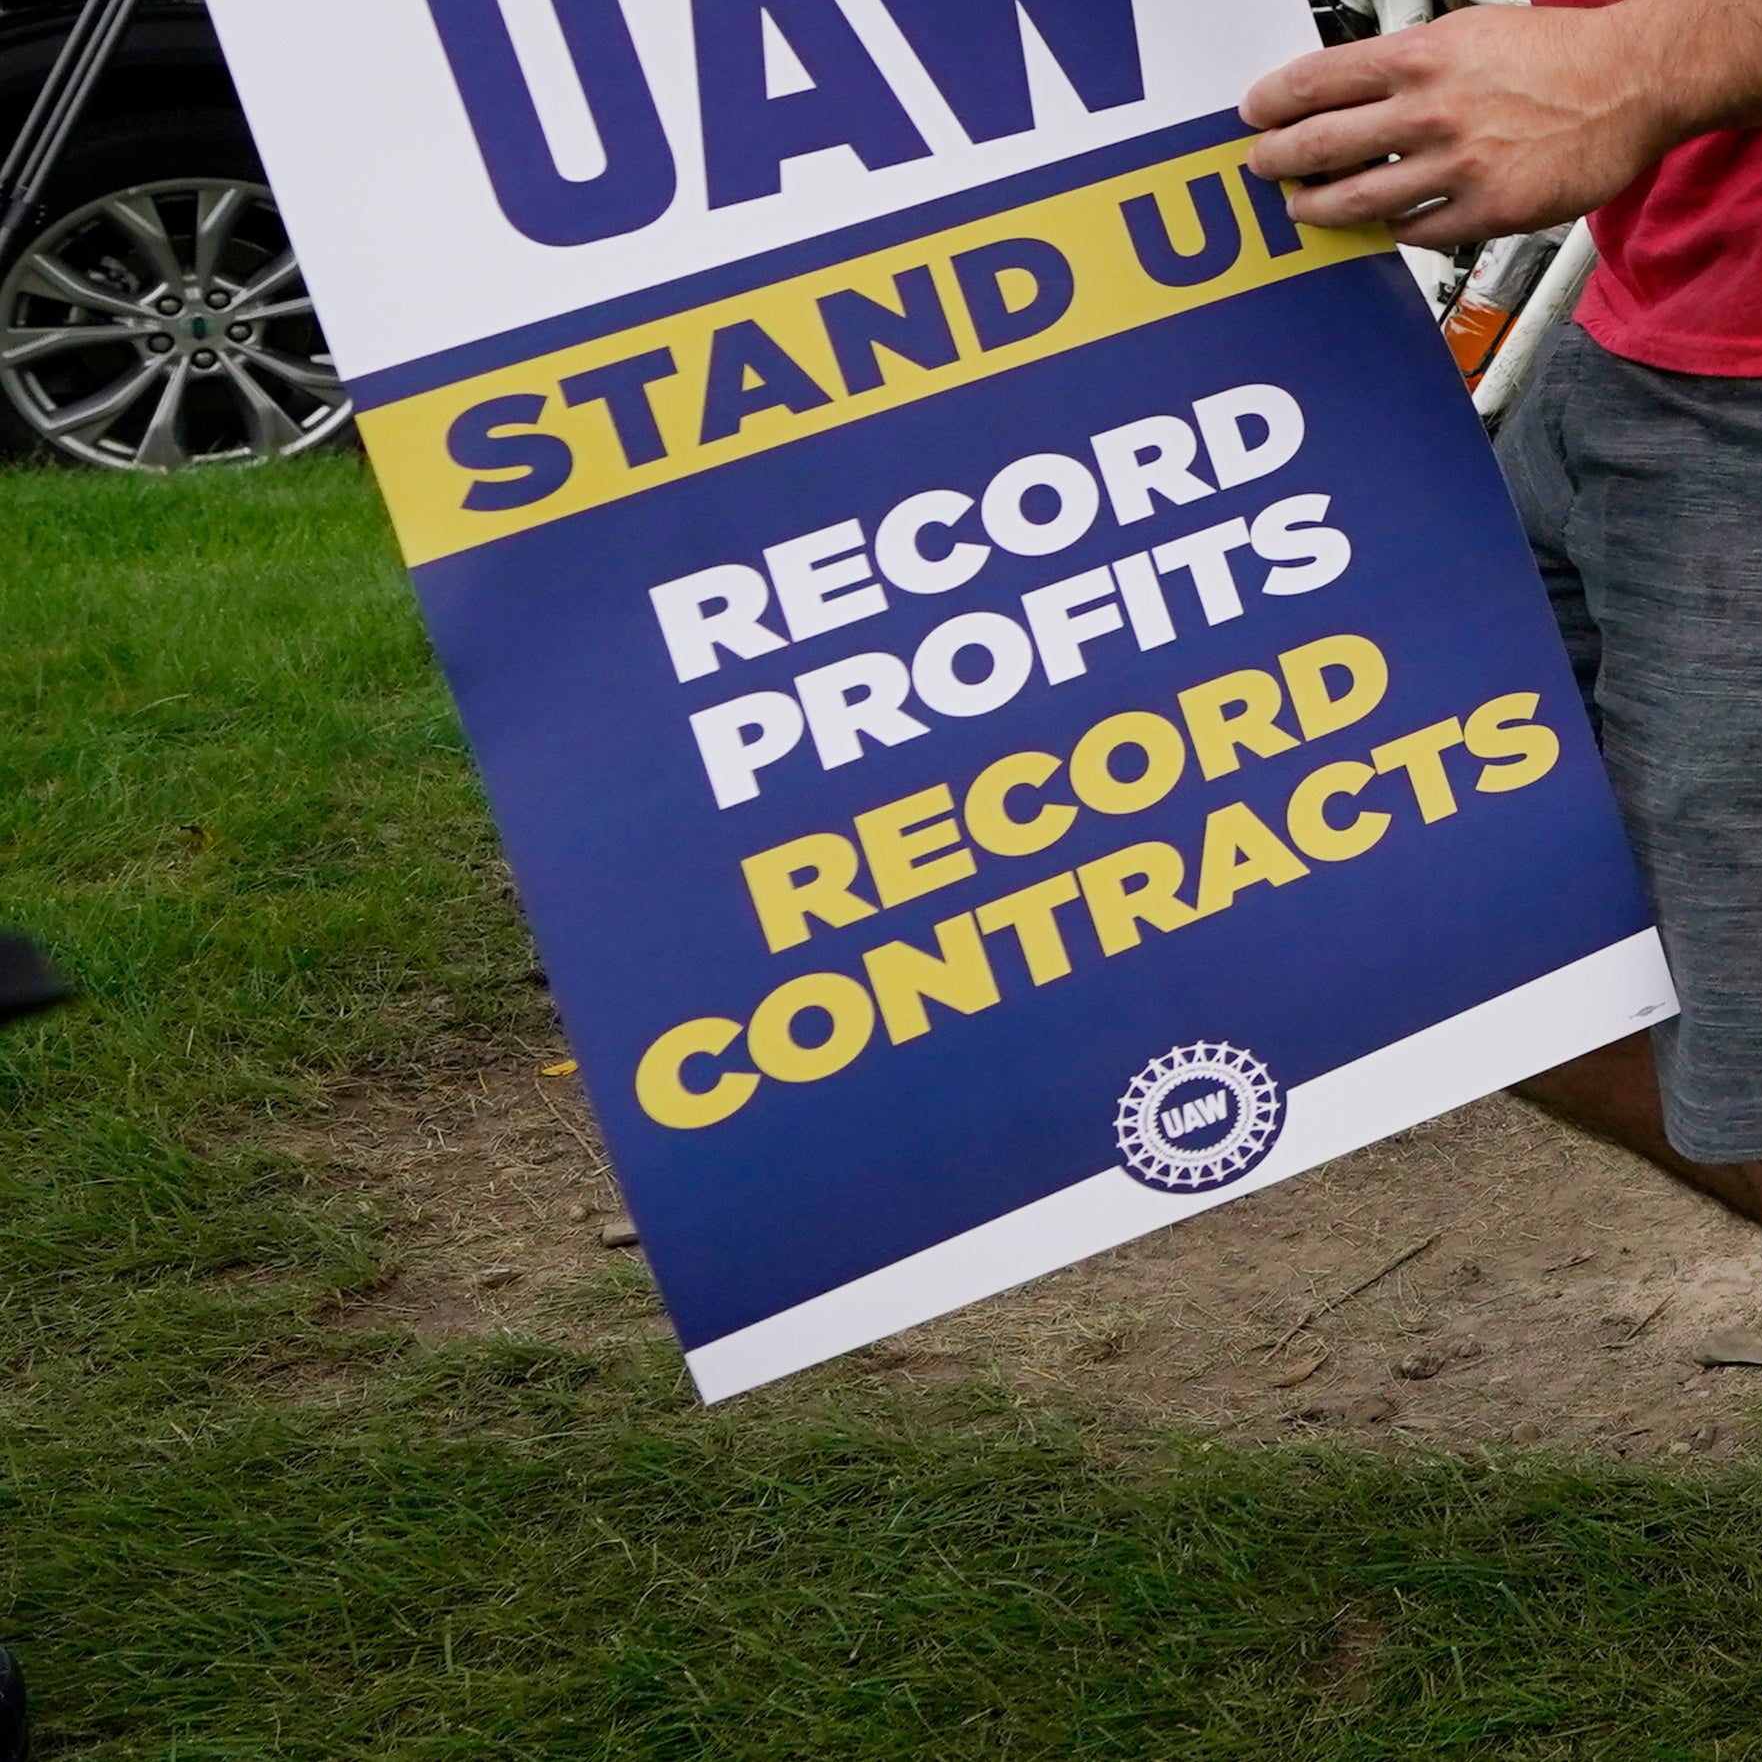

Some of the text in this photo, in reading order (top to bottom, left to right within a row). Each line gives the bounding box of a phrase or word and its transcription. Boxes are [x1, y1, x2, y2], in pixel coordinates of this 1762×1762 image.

[448, 238, 1073, 511] STAND
[649, 384, 1304, 683] RECORD
[689, 494, 1351, 809] PROFITS
[637, 694, 1557, 1127] CONTRACTS
[743, 637, 1385, 951] RECORD
[1160, 1089, 1228, 1139] UAW
